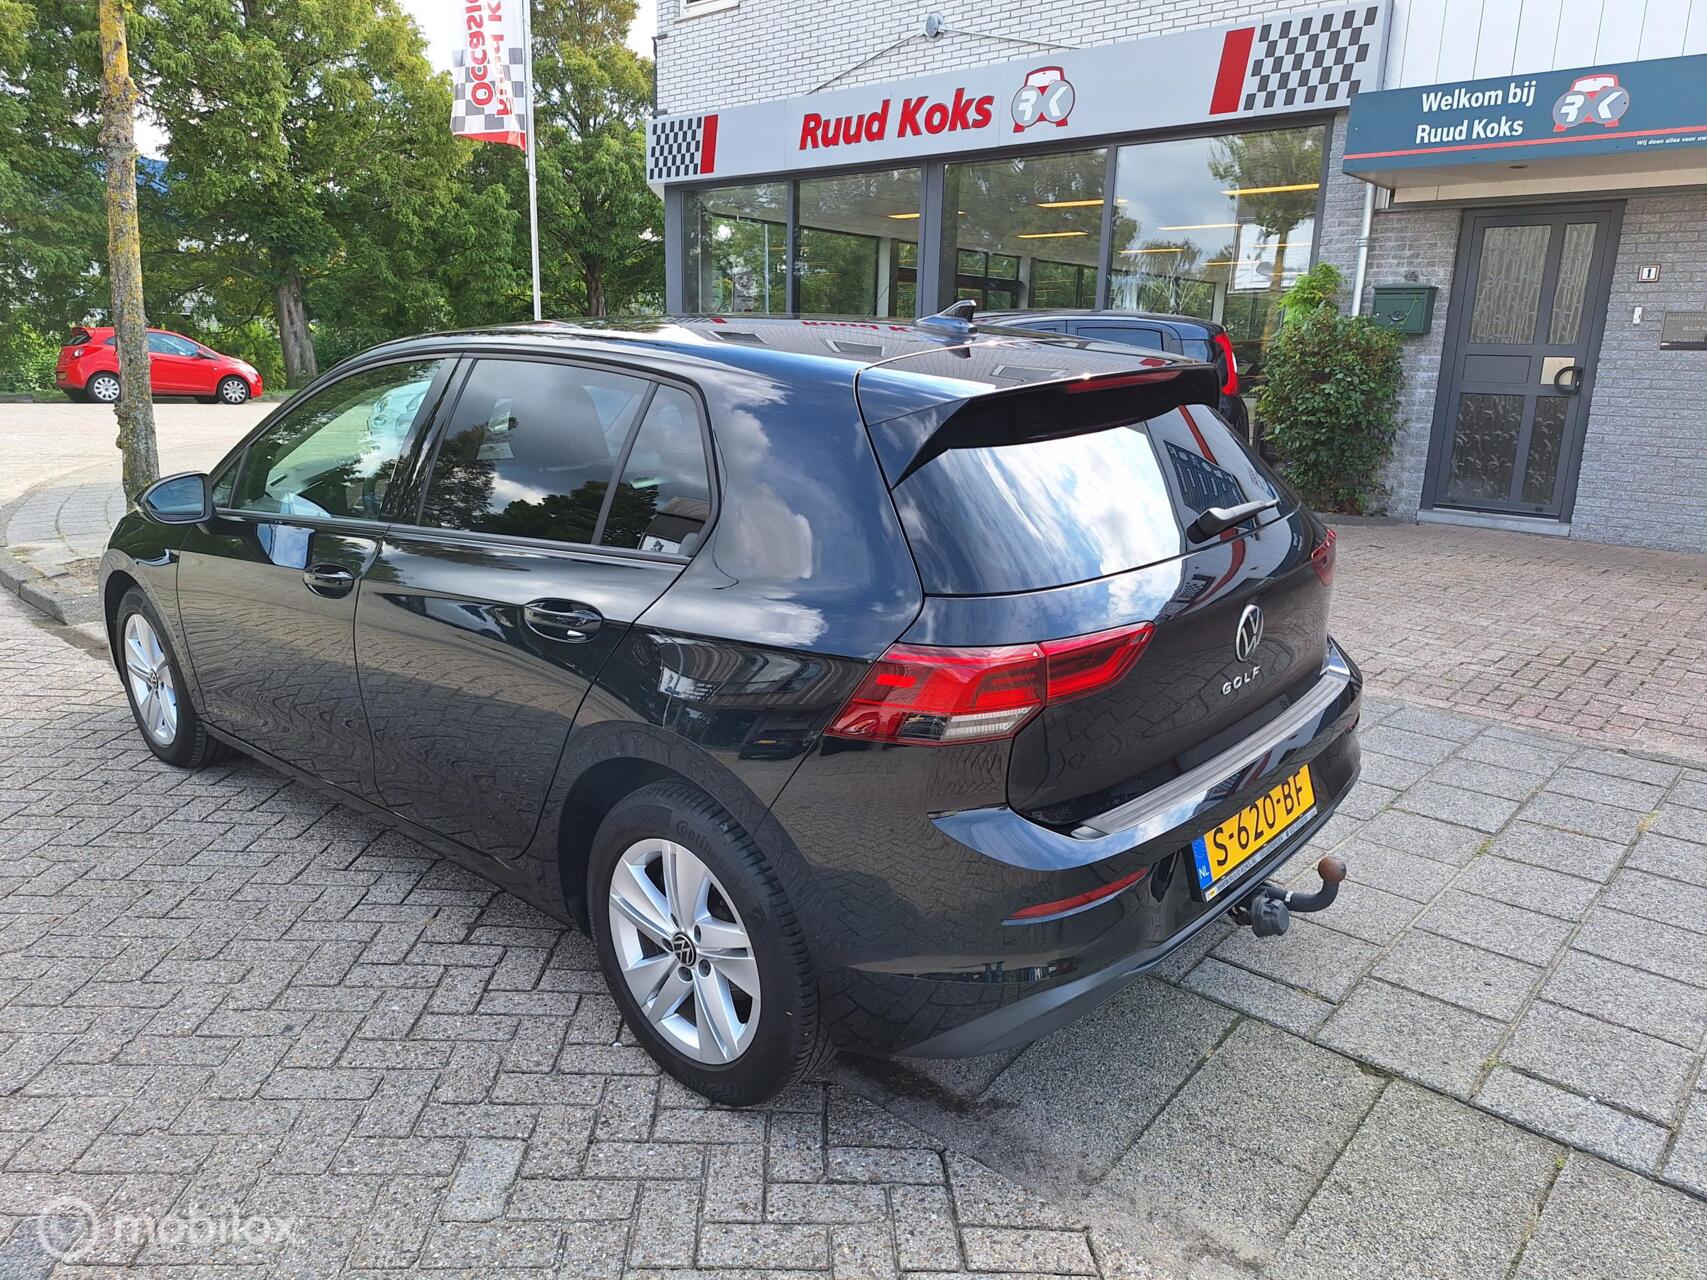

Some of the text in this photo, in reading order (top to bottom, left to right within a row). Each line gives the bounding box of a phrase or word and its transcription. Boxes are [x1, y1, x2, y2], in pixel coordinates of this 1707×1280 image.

[1422, 80, 1536, 112] Welkom bij
[799, 88, 995, 150] Ruud Koks
[1415, 116, 1524, 144] Ruud Koks
[1647, 268, 1652, 278] 1
[1221, 665, 1261, 696] GOLF
[1212, 771, 1303, 867] S-620-BF
[1198, 865, 1210, 880] NL
